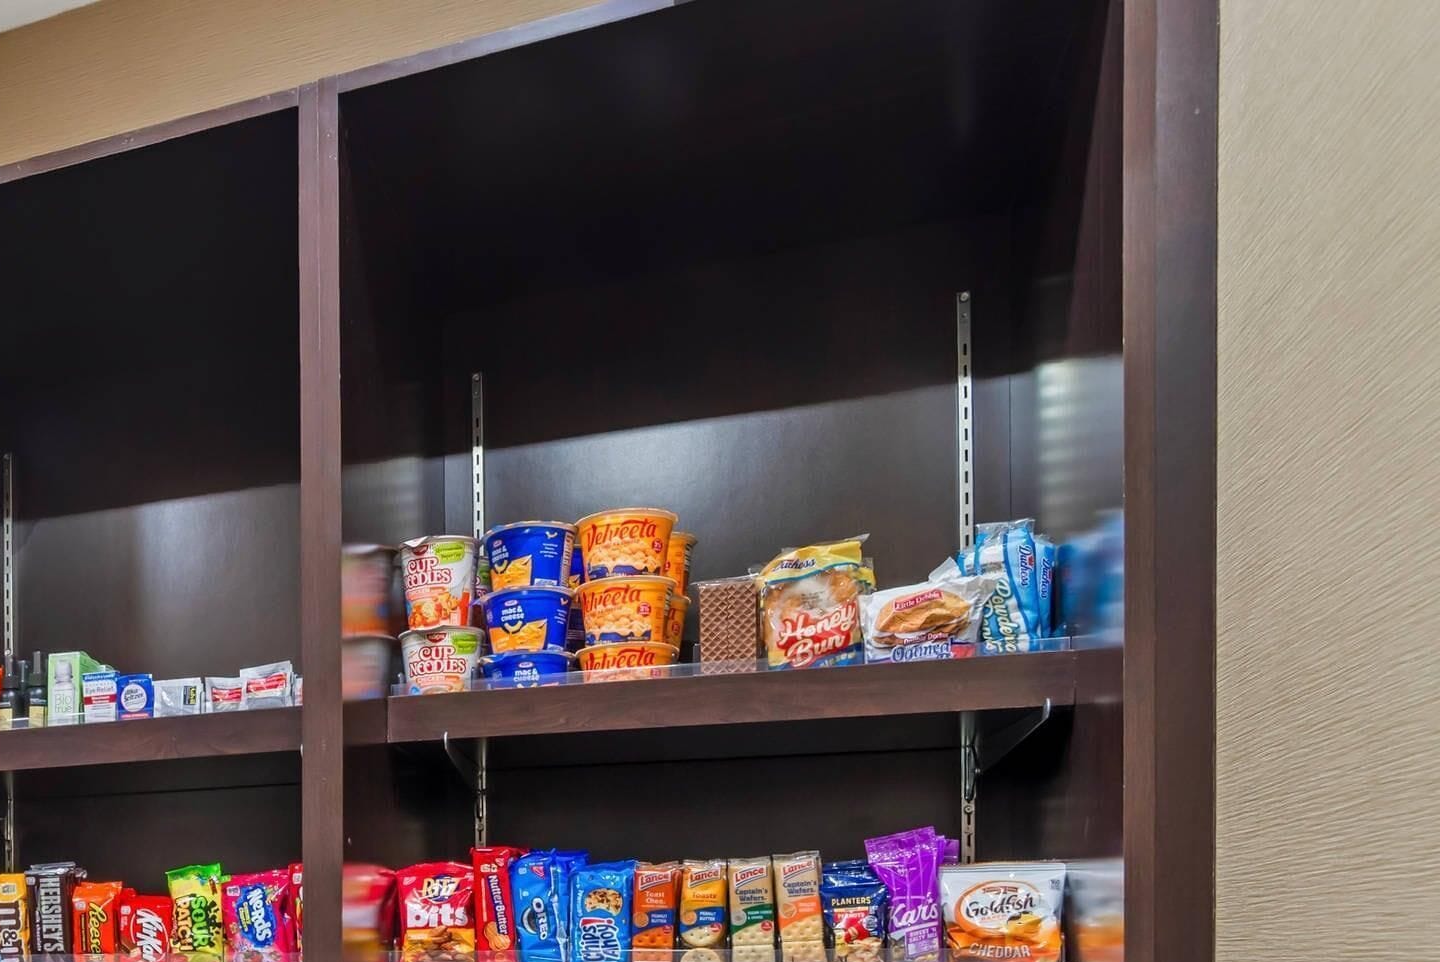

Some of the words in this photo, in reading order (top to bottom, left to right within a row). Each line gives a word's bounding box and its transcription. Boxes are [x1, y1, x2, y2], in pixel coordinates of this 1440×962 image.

[587, 518, 657, 551] Velveeta
[408, 558, 437, 574] CUP
[1019, 545, 1032, 587] Duchess
[1041, 557, 1051, 600] Duchess
[896, 600, 915, 610] Little
[916, 591, 940, 604] Debbie
[779, 603, 856, 645] Honey
[420, 645, 456, 661] CUP
[786, 633, 846, 667] Bun
[409, 658, 466, 677] NOODLES
[515, 668, 530, 676] mac
[586, 648, 656, 681] Velveeta
[640, 872, 669, 886] Lance
[690, 870, 719, 881] Lance
[735, 867, 764, 883] Lance
[783, 860, 813, 875] Lance
[421, 877, 462, 899] RITZ
[831, 896, 871, 906] PLANTERS
[39, 876, 64, 952] HERSHEY'S
[246, 888, 273, 942] Nerds
[532, 897, 548, 940] OREO
[966, 893, 1036, 919] Goldfish
[88, 901, 107, 962] Reese
[175, 896, 195, 951] PATCH
[190, 895, 210, 948] SOUR
[968, 942, 1031, 958] CHEDDAR
